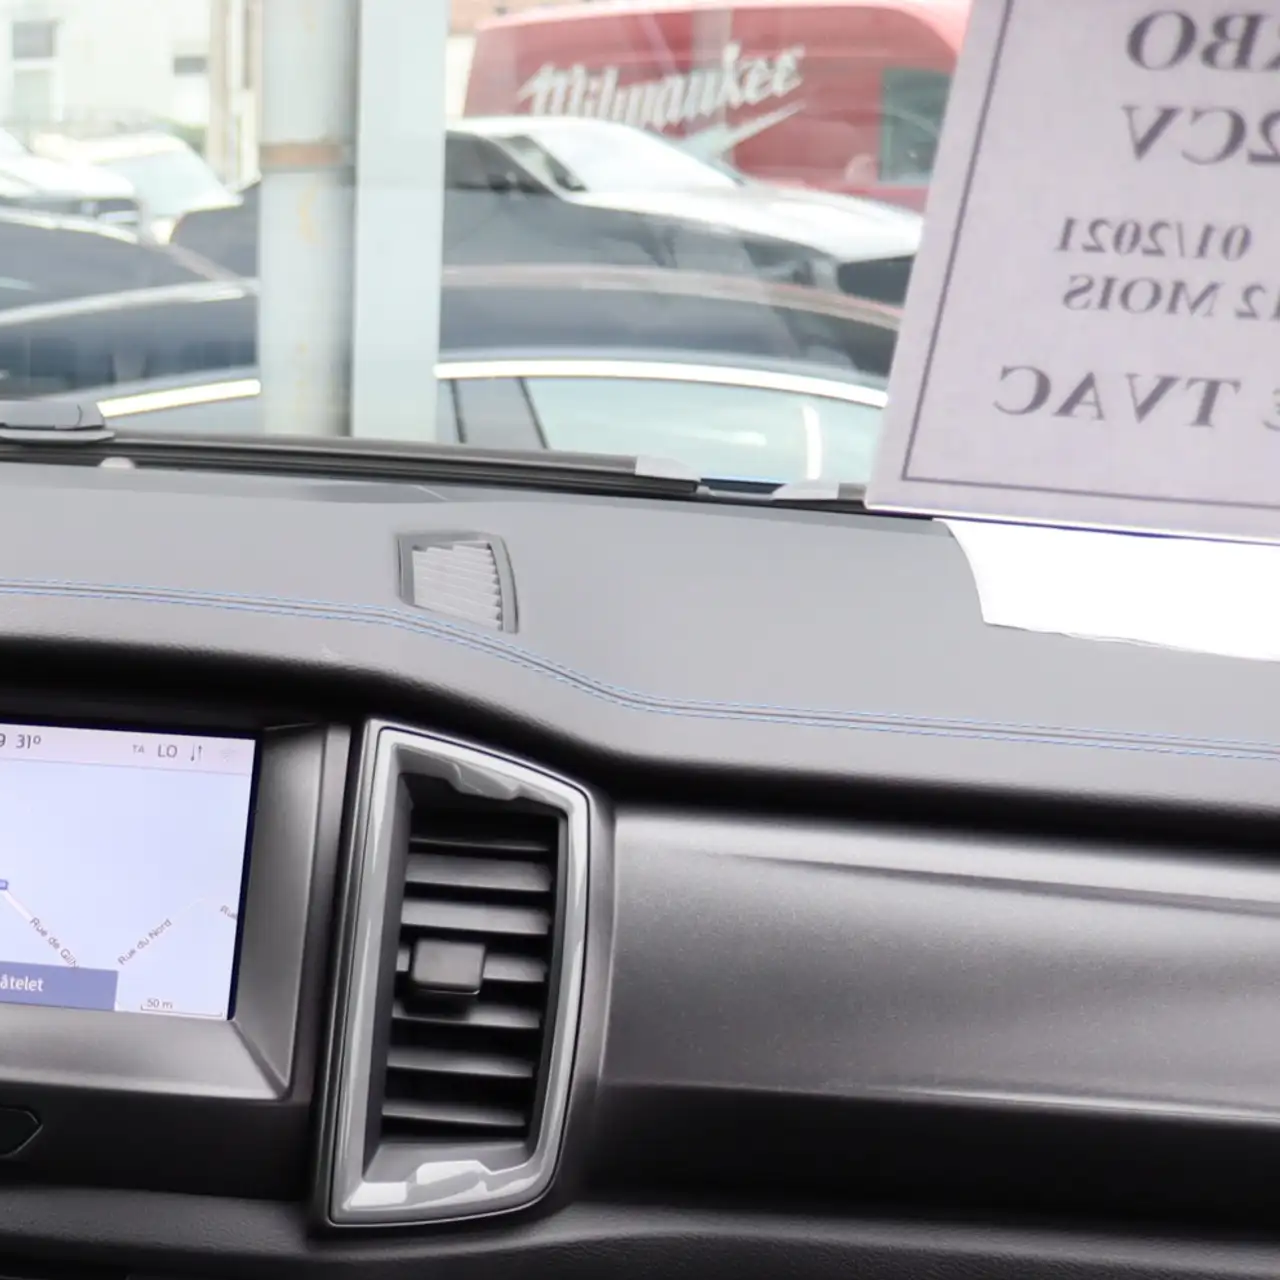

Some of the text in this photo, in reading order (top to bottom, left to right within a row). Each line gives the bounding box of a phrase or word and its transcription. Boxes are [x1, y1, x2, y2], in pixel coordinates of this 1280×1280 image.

[517, 42, 806, 132] Milwaukee
[157, 744, 178, 758] LO
[29, 917, 48, 937] Rue
[48, 936, 61, 950] de
[117, 948, 137, 966] Rue
[148, 918, 173, 941] Nord
[146, 998, 174, 1010] 50 m
